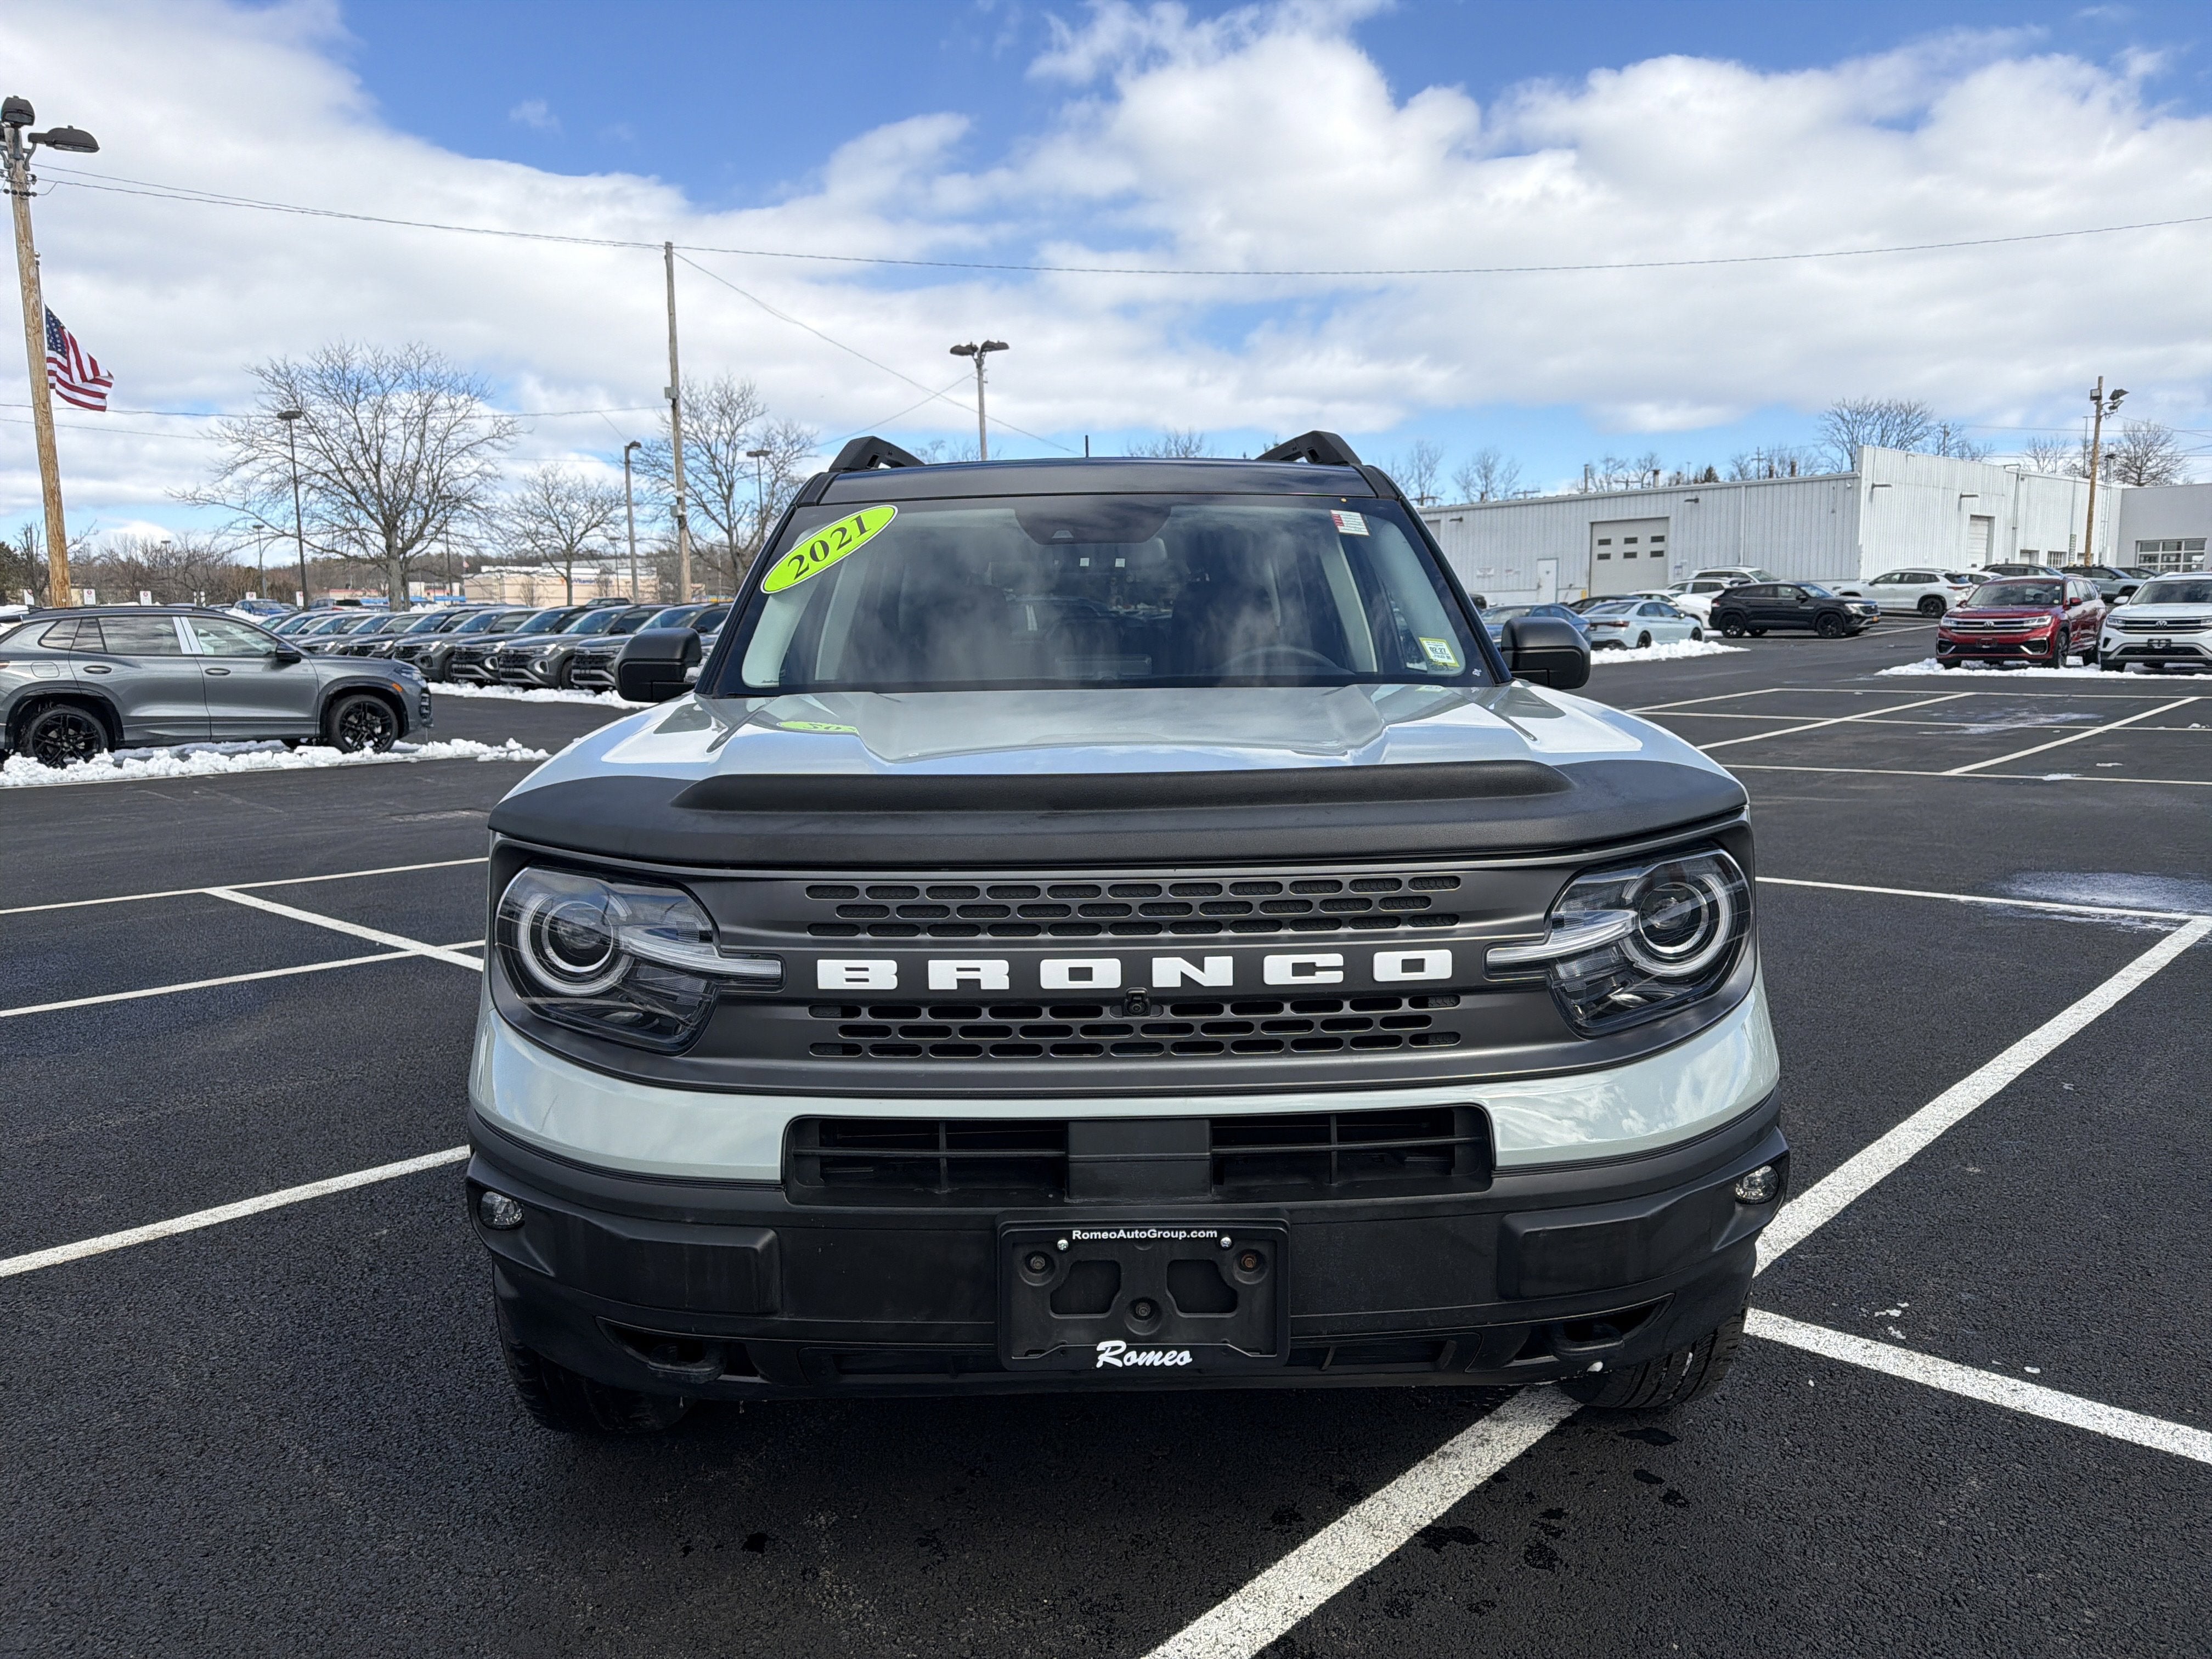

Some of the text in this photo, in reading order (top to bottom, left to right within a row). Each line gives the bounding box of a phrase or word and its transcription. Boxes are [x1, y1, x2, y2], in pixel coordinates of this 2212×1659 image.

[788, 515, 871, 580] 2021
[817, 949, 1452, 990] BRONCO
[1072, 1229, 1217, 1240] RomeoAutoGroup.com
[1096, 1340, 1193, 1368] Romeo
